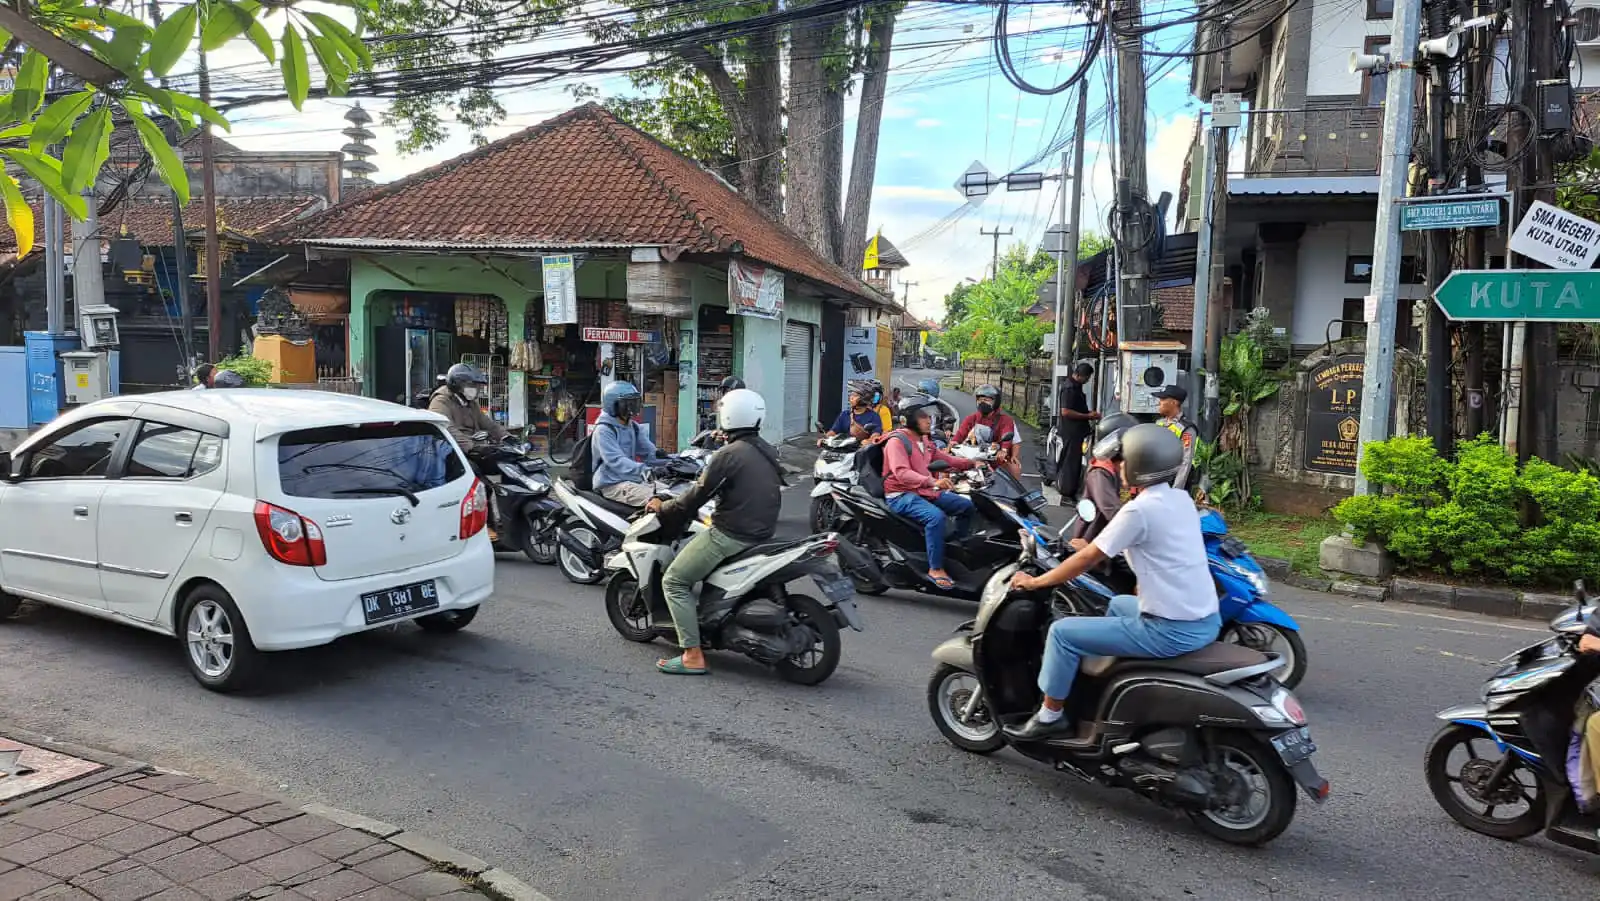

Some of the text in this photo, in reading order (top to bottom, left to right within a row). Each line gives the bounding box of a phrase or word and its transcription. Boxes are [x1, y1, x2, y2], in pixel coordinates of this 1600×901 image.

[1532, 207, 1556, 228] SMA
[1554, 216, 1595, 243] NEGERI
[1526, 225, 1588, 260] KUTA UTARA
[1470, 281, 1583, 309] KUTA
[586, 328, 625, 341] PERTAMINI
[365, 596, 380, 613] DK
[387, 588, 413, 607] 1381
